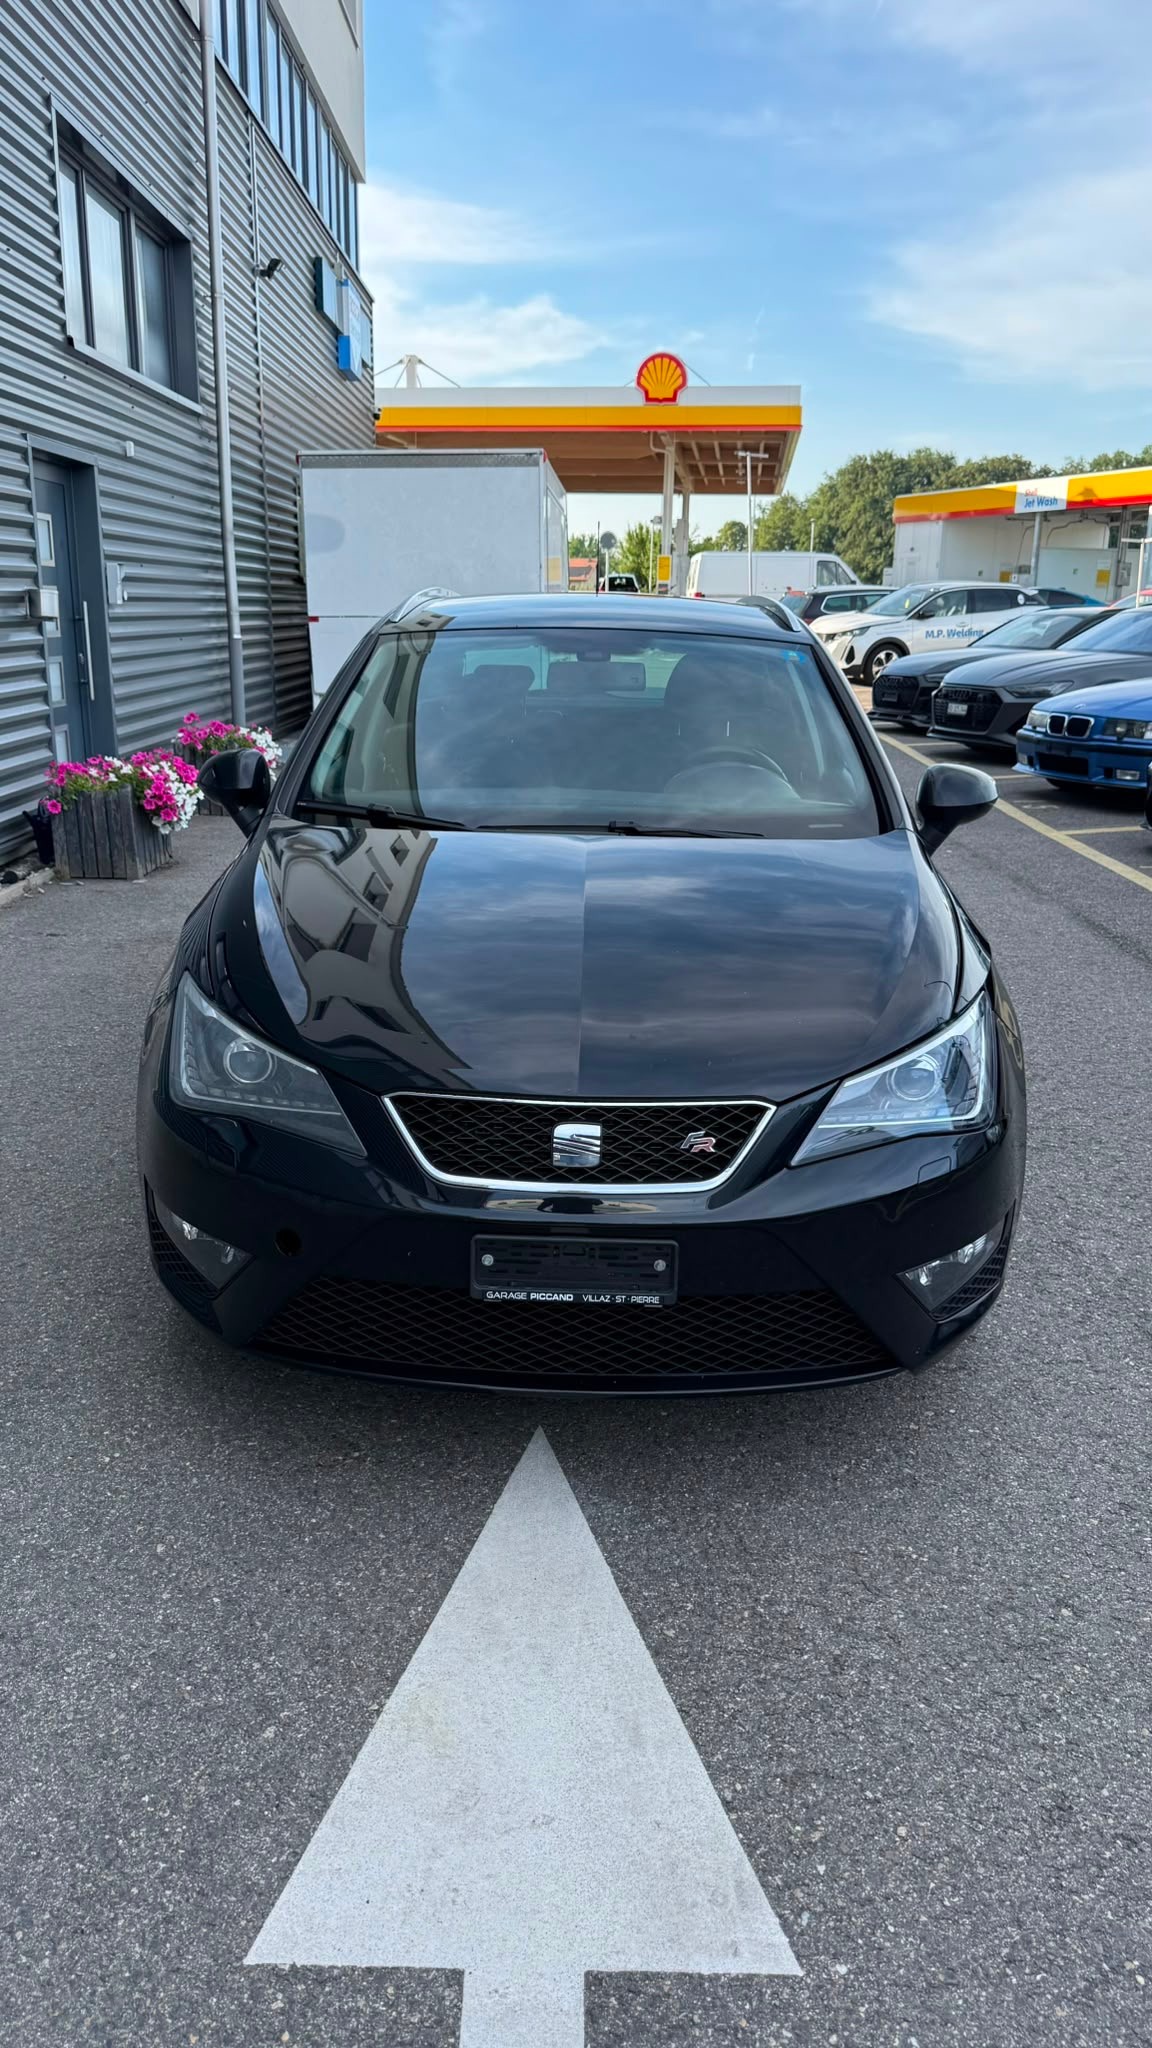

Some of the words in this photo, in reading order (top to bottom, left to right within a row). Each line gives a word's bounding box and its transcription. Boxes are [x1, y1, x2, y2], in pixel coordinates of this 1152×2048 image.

[1024, 498, 1035, 508] Jet
[1037, 496, 1058, 507] Wash
[925, 629, 946, 639] M.P.
[680, 1130, 716, 1152] FR
[486, 1291, 527, 1300] GARAGE
[530, 1292, 574, 1301] PICCAND
